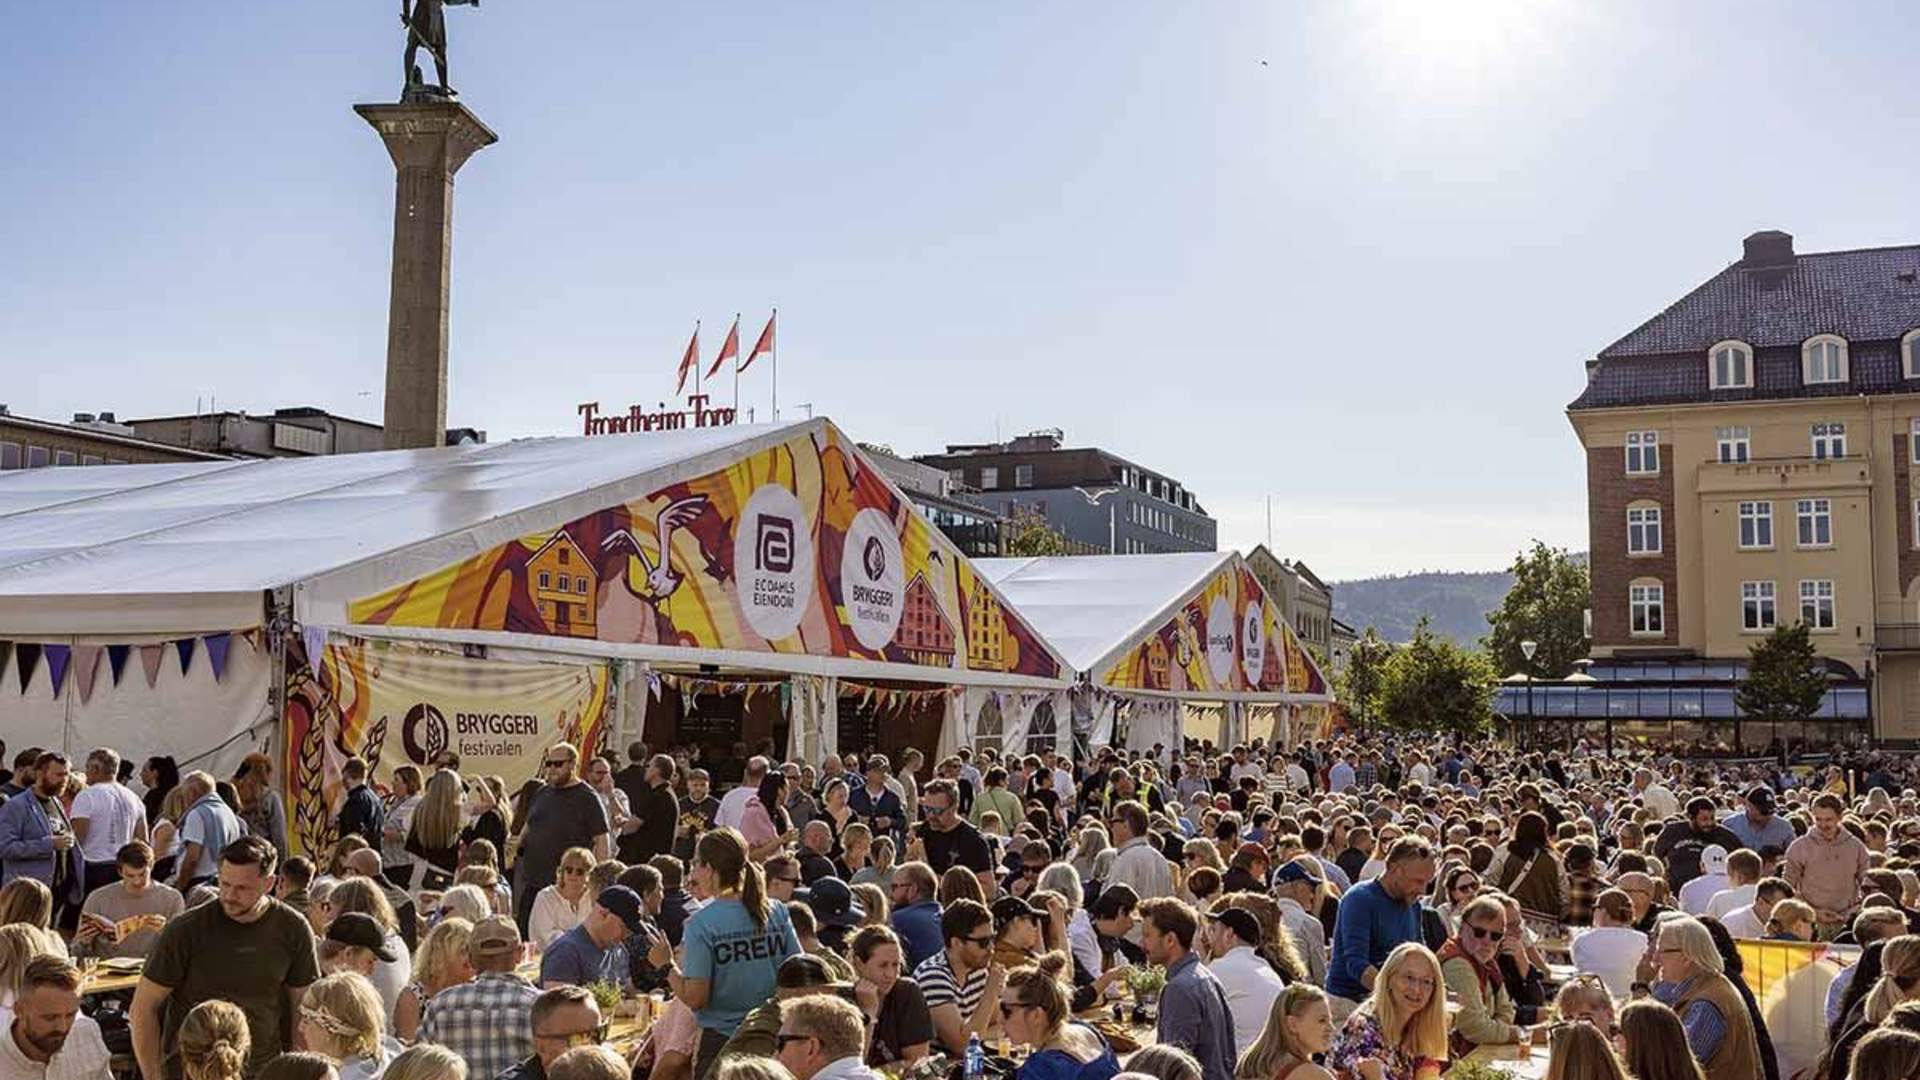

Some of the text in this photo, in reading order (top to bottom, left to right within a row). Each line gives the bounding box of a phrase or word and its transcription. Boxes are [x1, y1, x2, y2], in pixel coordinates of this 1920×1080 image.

[578, 401, 686, 436] Trondheim
[852, 584, 894, 607] BRYGGERI
[456, 713, 538, 735] BRYGGERI
[458, 738, 522, 756] festivalen
[713, 933, 788, 965] CREW
